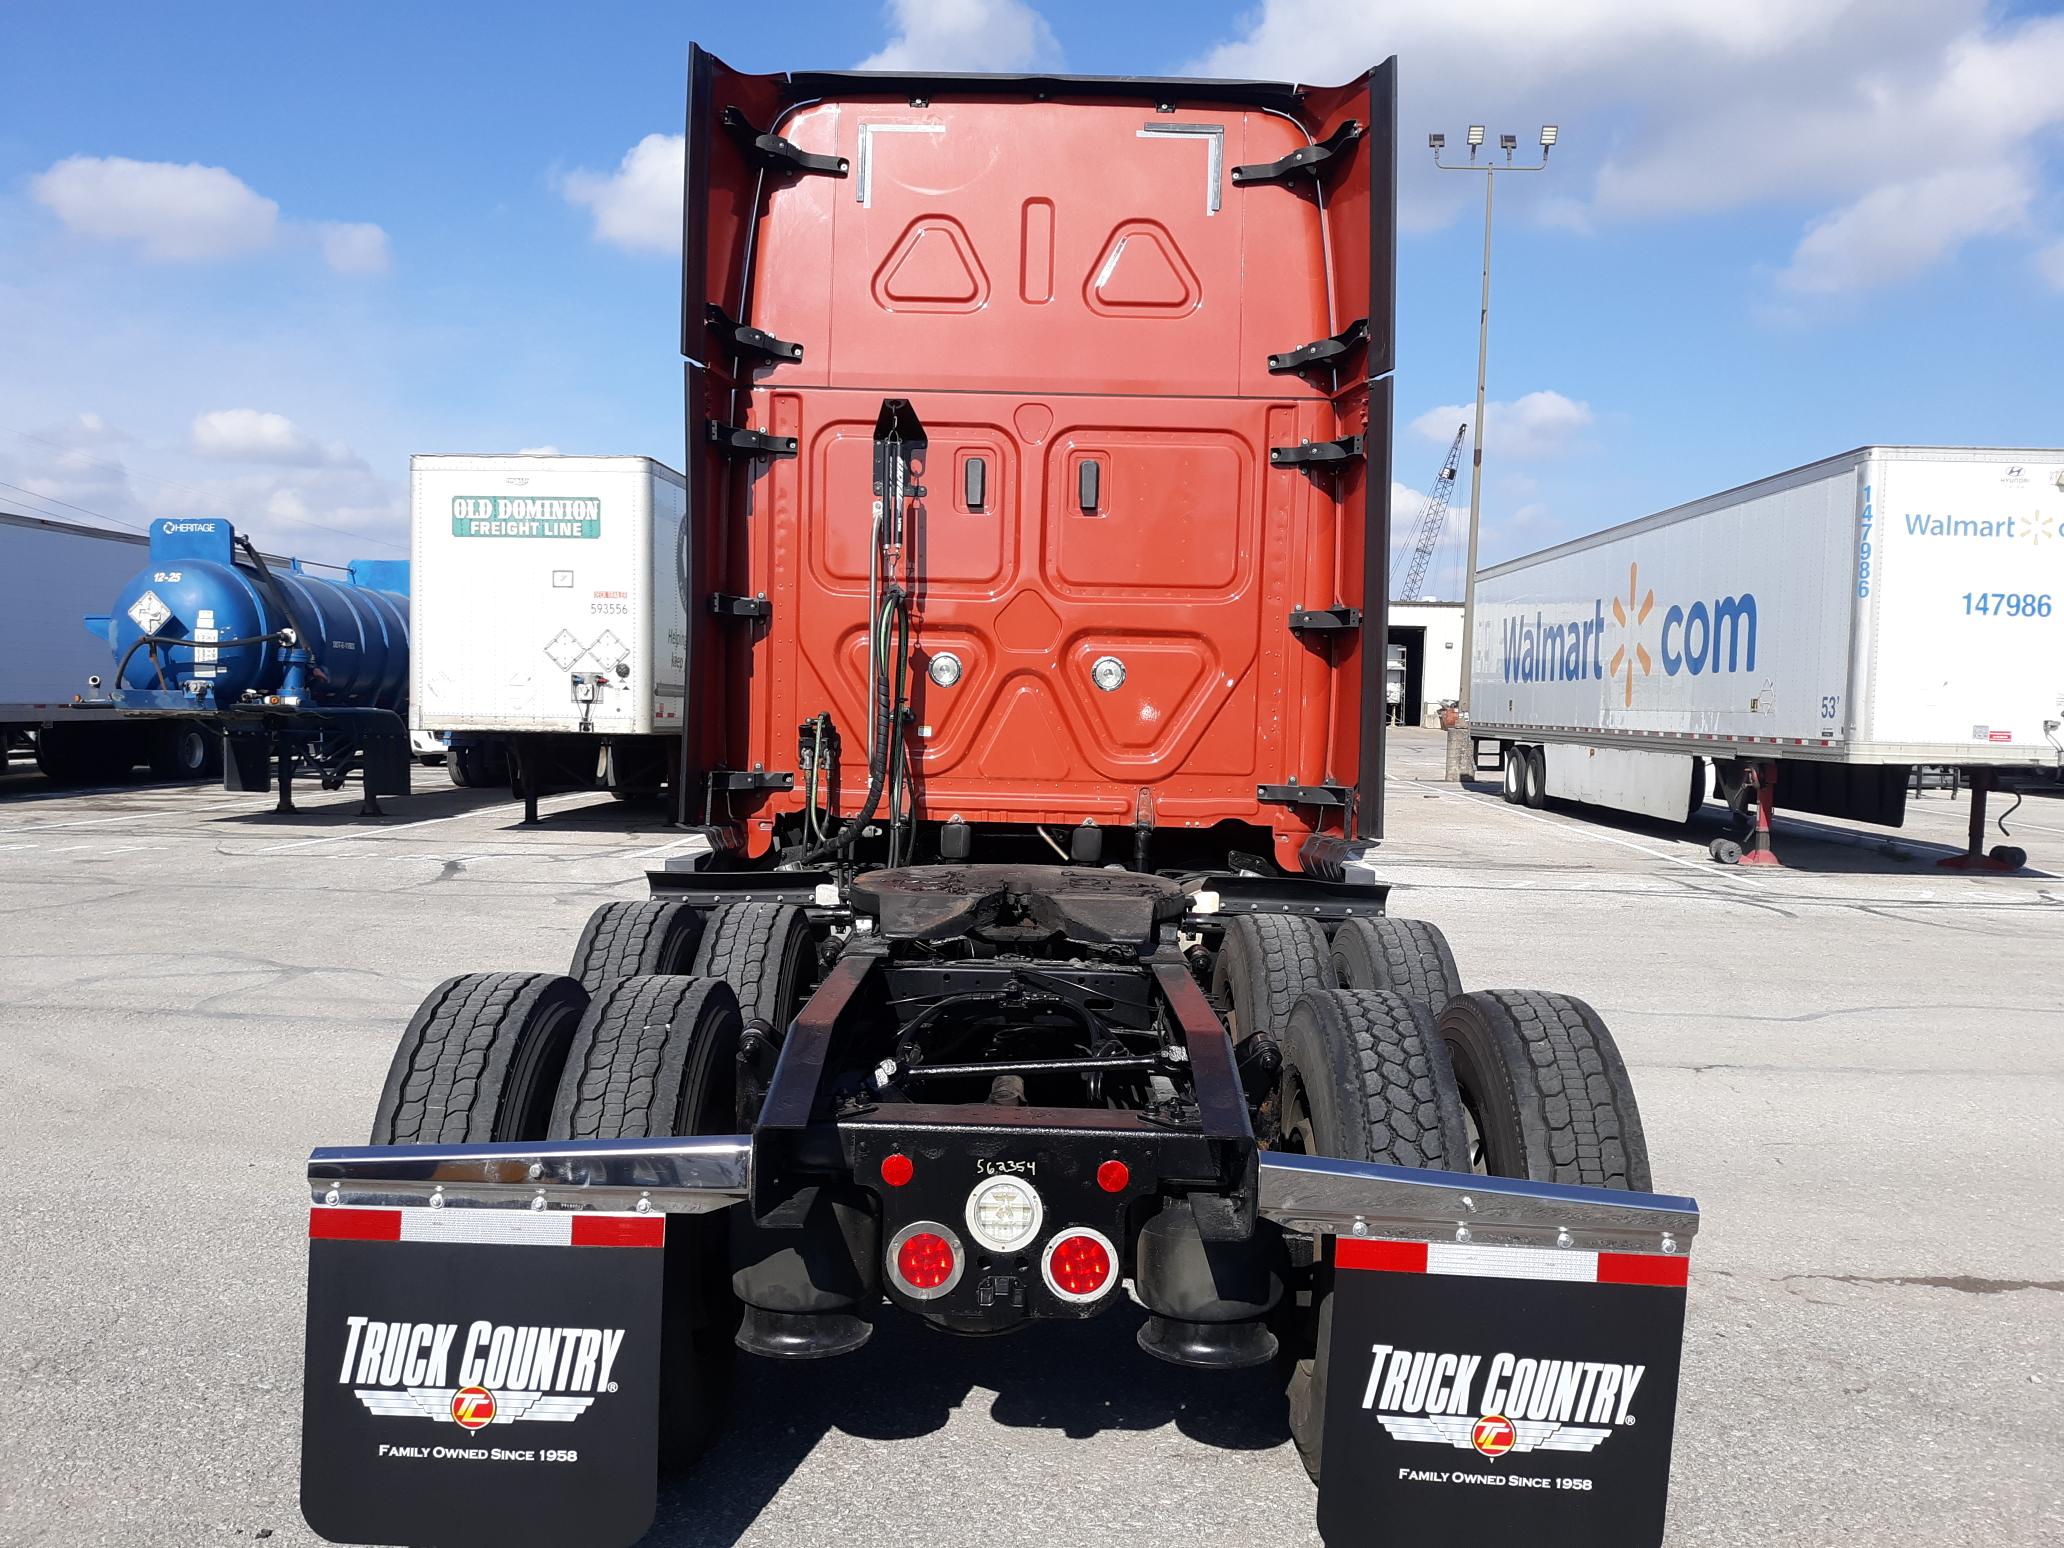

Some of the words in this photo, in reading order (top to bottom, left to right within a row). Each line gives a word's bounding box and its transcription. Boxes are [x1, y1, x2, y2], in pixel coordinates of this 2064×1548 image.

[454, 498, 493, 519] OLD
[498, 499, 599, 520] DOMINION
[175, 523, 216, 533] HERITAGE
[470, 520, 541, 536] FREIGHT
[544, 522, 583, 537] LINE
[1905, 513, 2015, 537] Walmart
[1857, 485, 1873, 598] 147986
[154, 572, 181, 582] 12-25
[590, 603, 628, 615] 593556
[1962, 592, 2052, 618] 147986
[1503, 598, 1605, 684] Walmart
[1661, 593, 1757, 677] com
[1821, 696, 1840, 719] 53'
[976, 1159, 1036, 1175] 562354
[338, 1316, 458, 1387] TRUCK
[1362, 1344, 1482, 1415] TRUCK
[378, 1444, 431, 1458] FAMILY
[432, 1446, 489, 1460] OWNED
[491, 1448, 535, 1461] SINCE
[539, 1450, 578, 1462] 1958
[1398, 1468, 1450, 1483] FAMILY
[1451, 1471, 1506, 1486] OWNED
[1508, 1475, 1551, 1489] SINCE
[1554, 1478, 1593, 1491] 1958
